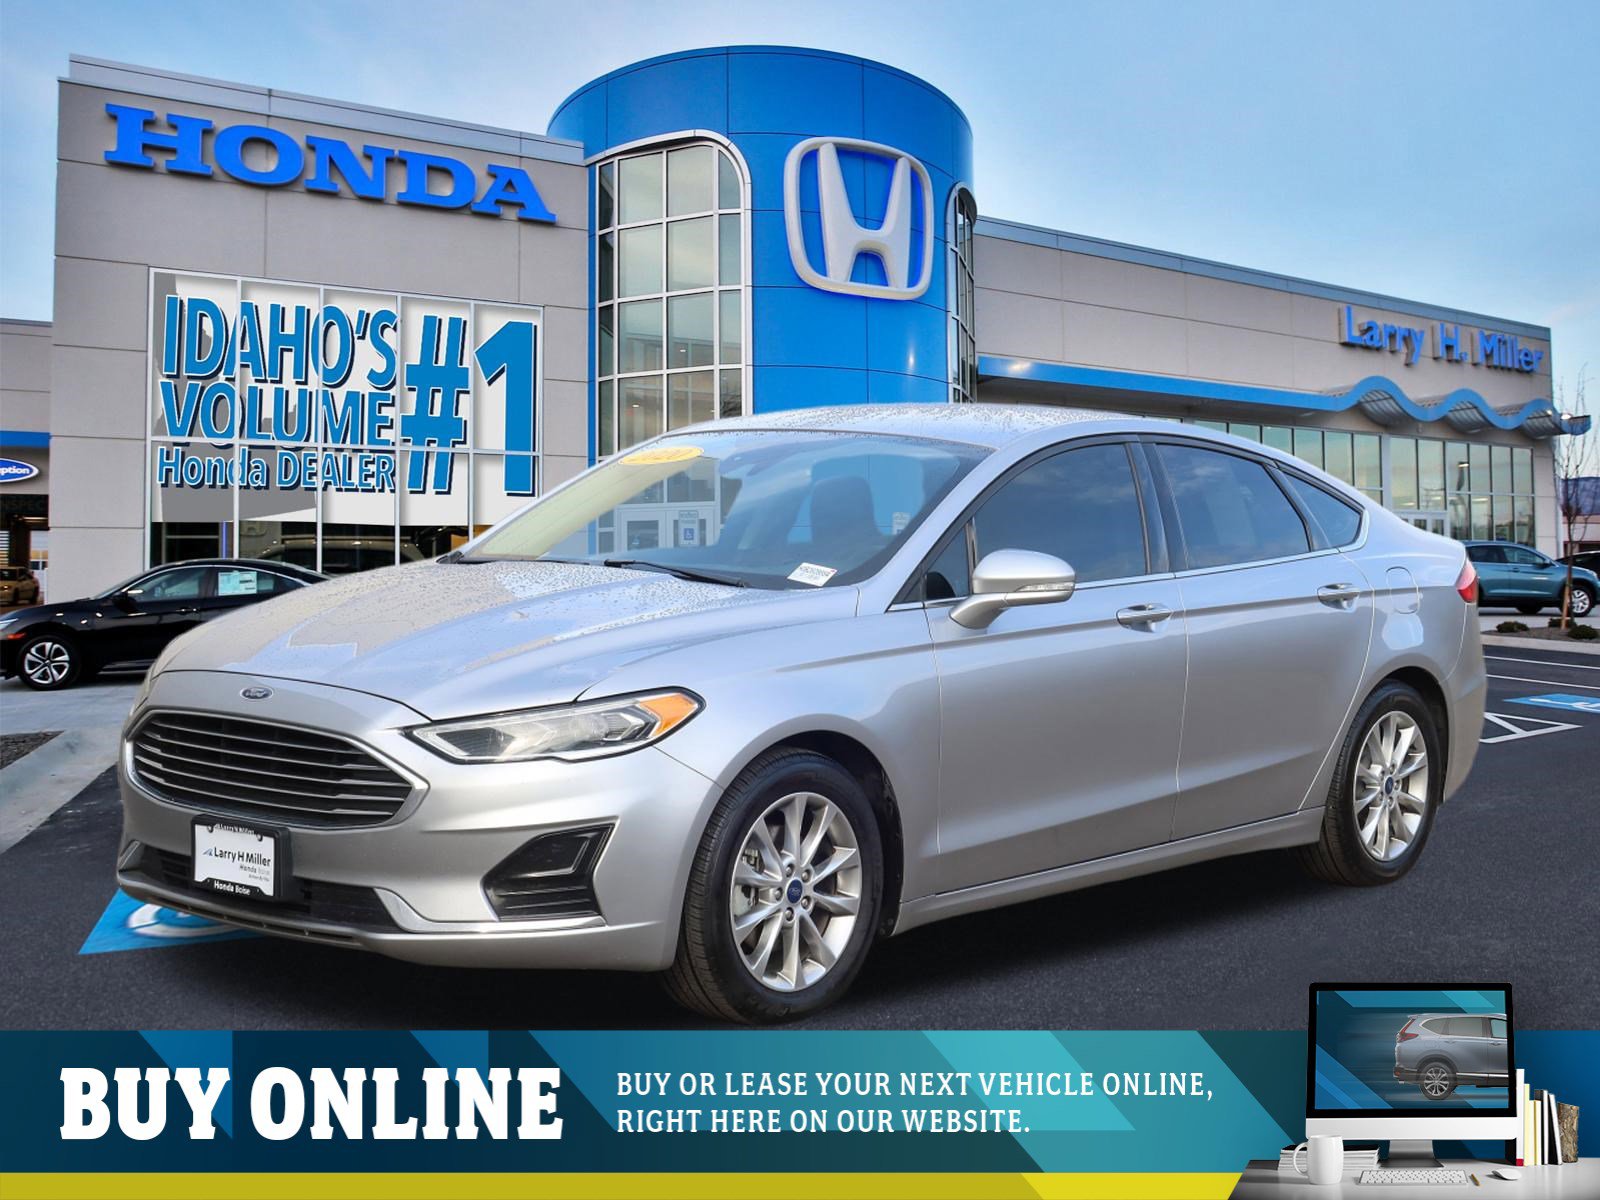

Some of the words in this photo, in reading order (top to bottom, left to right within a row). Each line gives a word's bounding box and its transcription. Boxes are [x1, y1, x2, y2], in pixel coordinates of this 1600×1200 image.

[104, 103, 557, 223] HONDA
[162, 294, 398, 391] IDAHO'S
[1343, 305, 1424, 366] Larry
[1438, 322, 1468, 362] H.
[1478, 329, 1543, 373] Miller
[159, 380, 397, 450] VOLUME
[400, 314, 537, 497] #1
[0, 465, 30, 476] ption
[156, 446, 269, 491] Honda
[276, 450, 396, 493] DEALER
[213, 880, 235, 892] Honda
[235, 884, 251, 896] Boise
[214, 846, 236, 863] Larry
[237, 851, 245, 862] H
[245, 852, 271, 867] Miller
